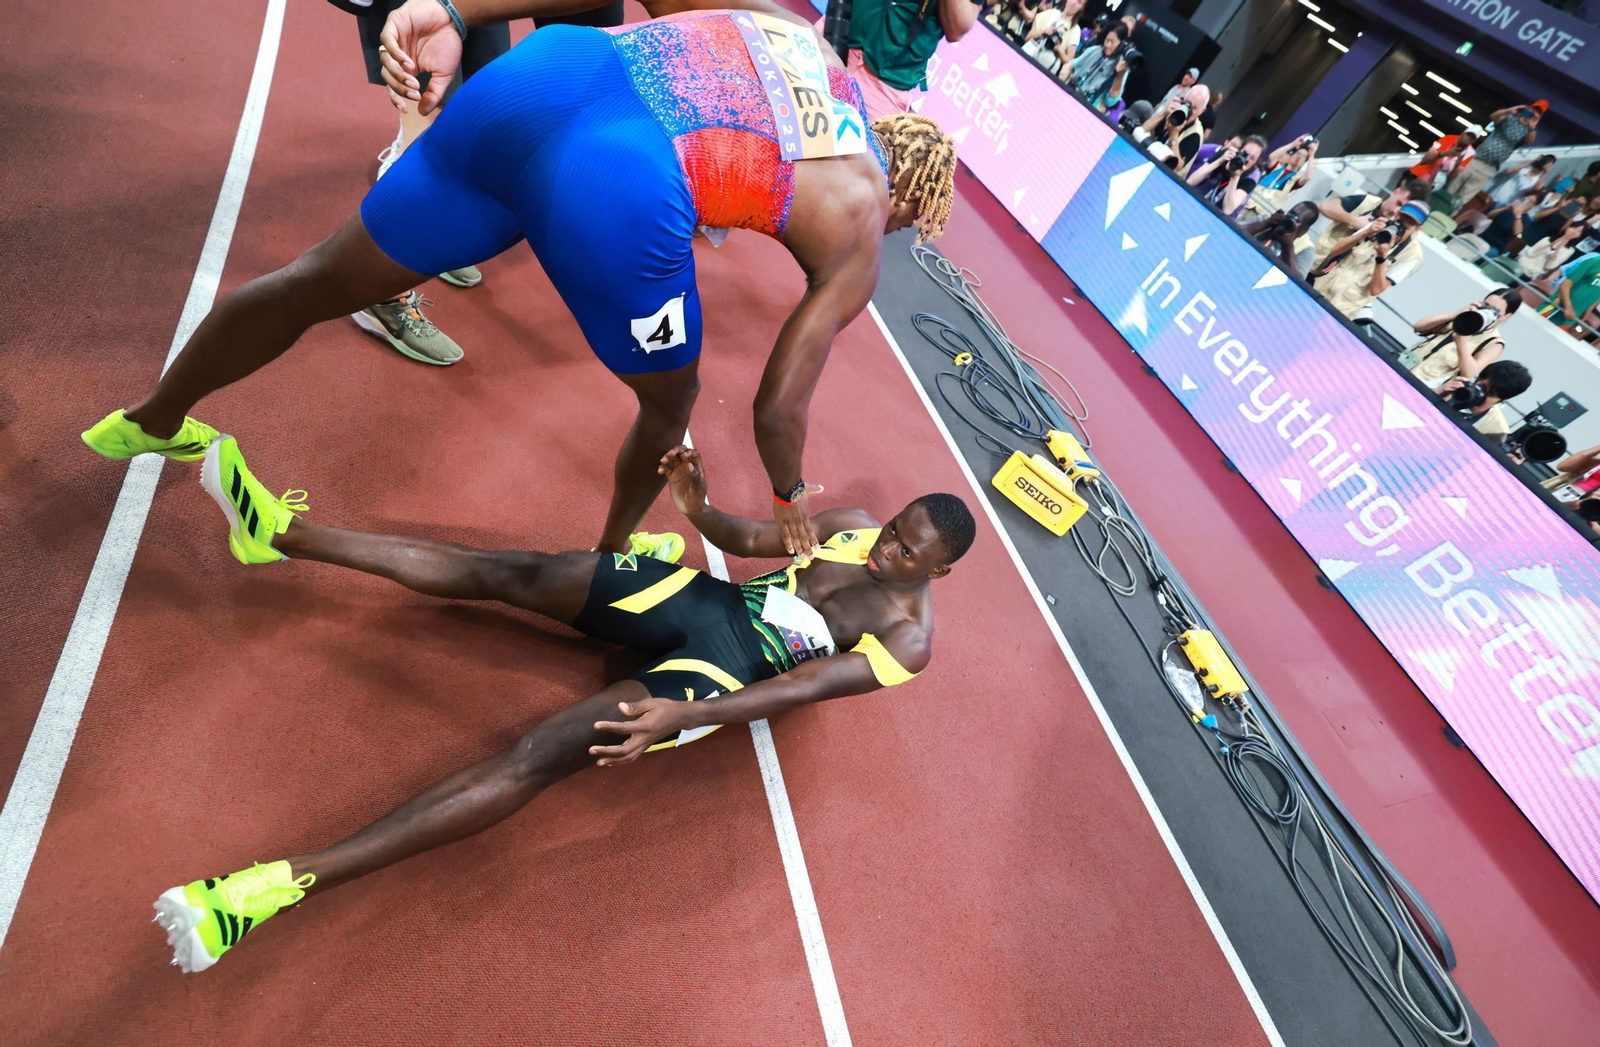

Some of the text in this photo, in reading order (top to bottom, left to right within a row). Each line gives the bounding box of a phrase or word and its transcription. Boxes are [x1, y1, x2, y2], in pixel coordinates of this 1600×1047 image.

[1447, 0, 1586, 62] HON GATE
[646, 313, 674, 345] 4
[1014, 476, 1063, 515] SEIKO
[1141, 257, 1600, 757] In Everything, Bette
